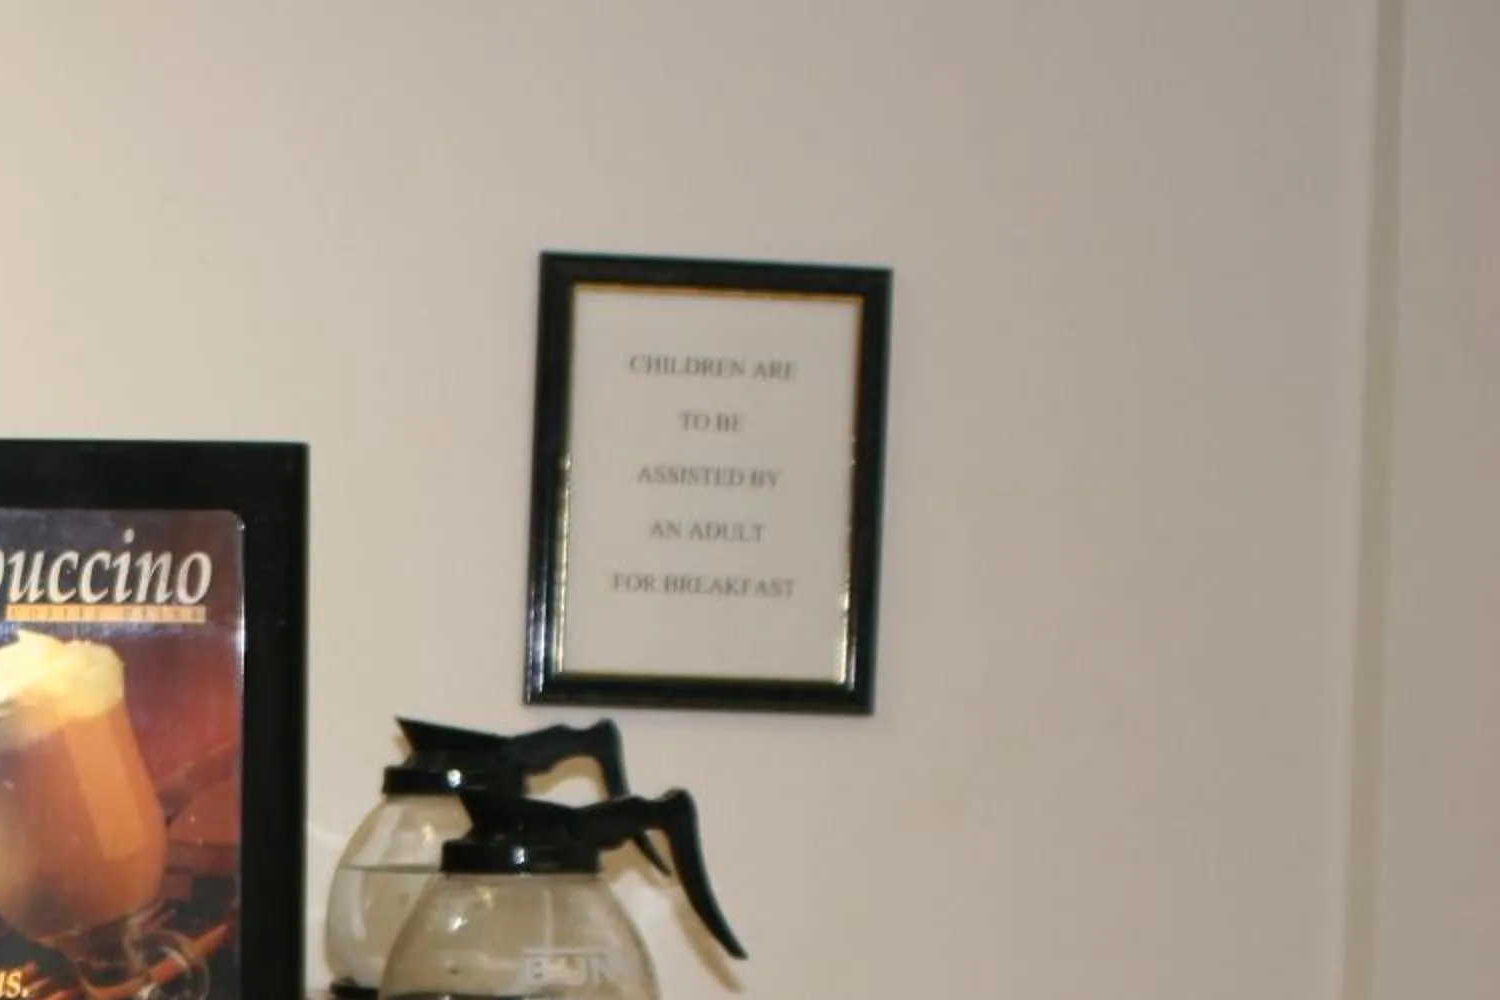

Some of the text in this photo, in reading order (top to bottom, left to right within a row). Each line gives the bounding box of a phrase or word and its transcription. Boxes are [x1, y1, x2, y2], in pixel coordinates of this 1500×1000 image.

[629, 354, 799, 380] CHILDREN ARE
[680, 411, 741, 432] TO BE
[638, 465, 782, 489] ASSISTED BY
[650, 519, 765, 543] AN ADULT
[613, 572, 796, 599] FOR BREAKFAST
